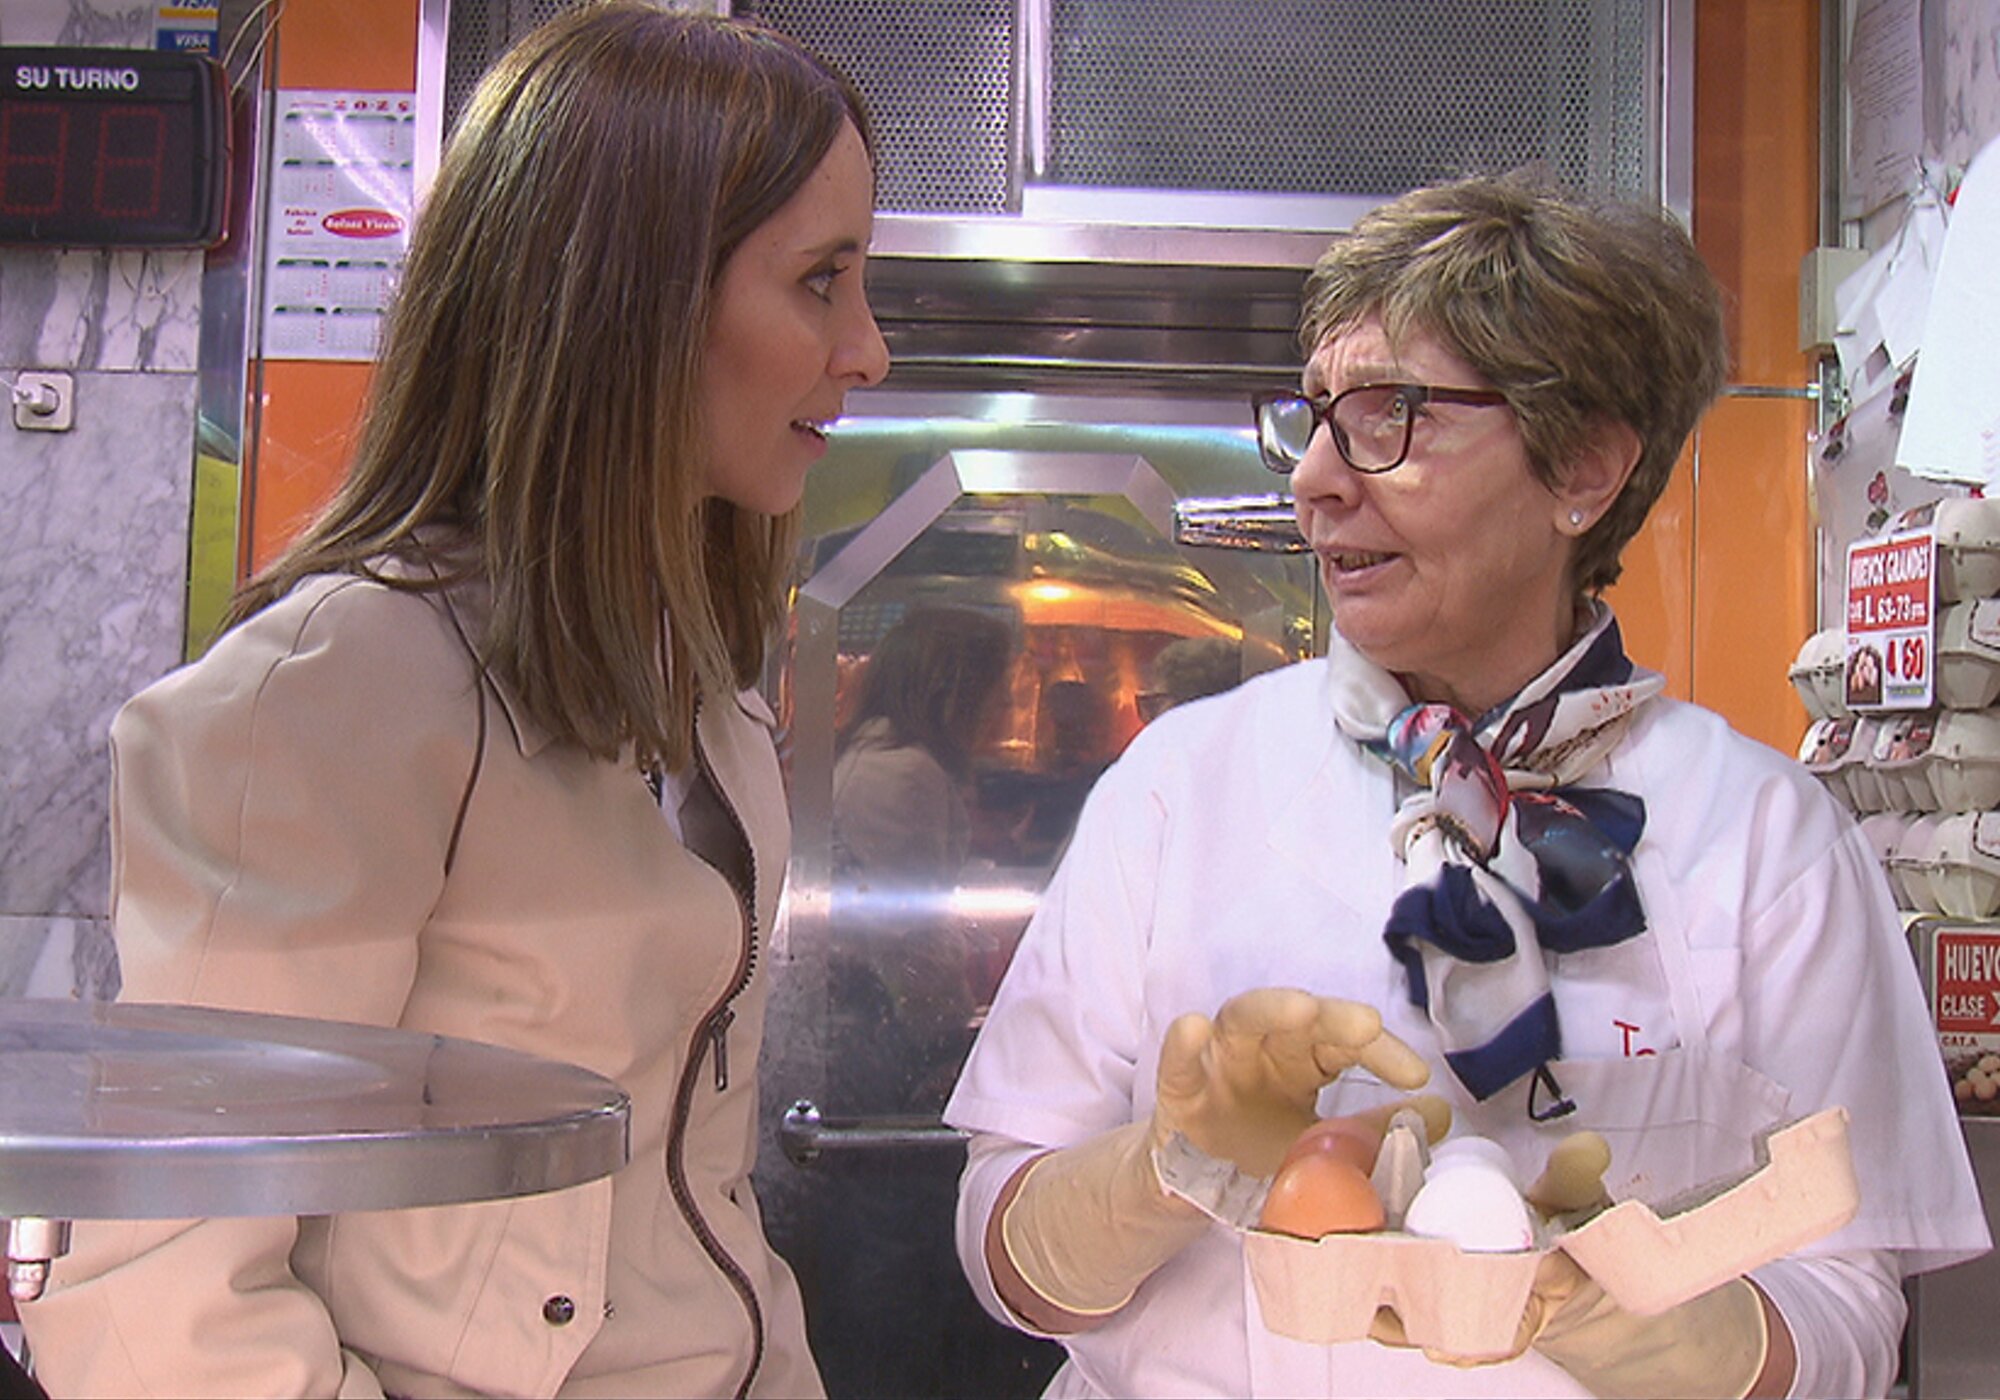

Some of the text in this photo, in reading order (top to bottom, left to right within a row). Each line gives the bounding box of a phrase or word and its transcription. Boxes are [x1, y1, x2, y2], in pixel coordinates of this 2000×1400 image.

[176, 32, 209, 48] VISA
[16, 65, 139, 91] SU TURNO
[1865, 594, 1876, 625] L
[1941, 994, 1985, 1018] CLASE
